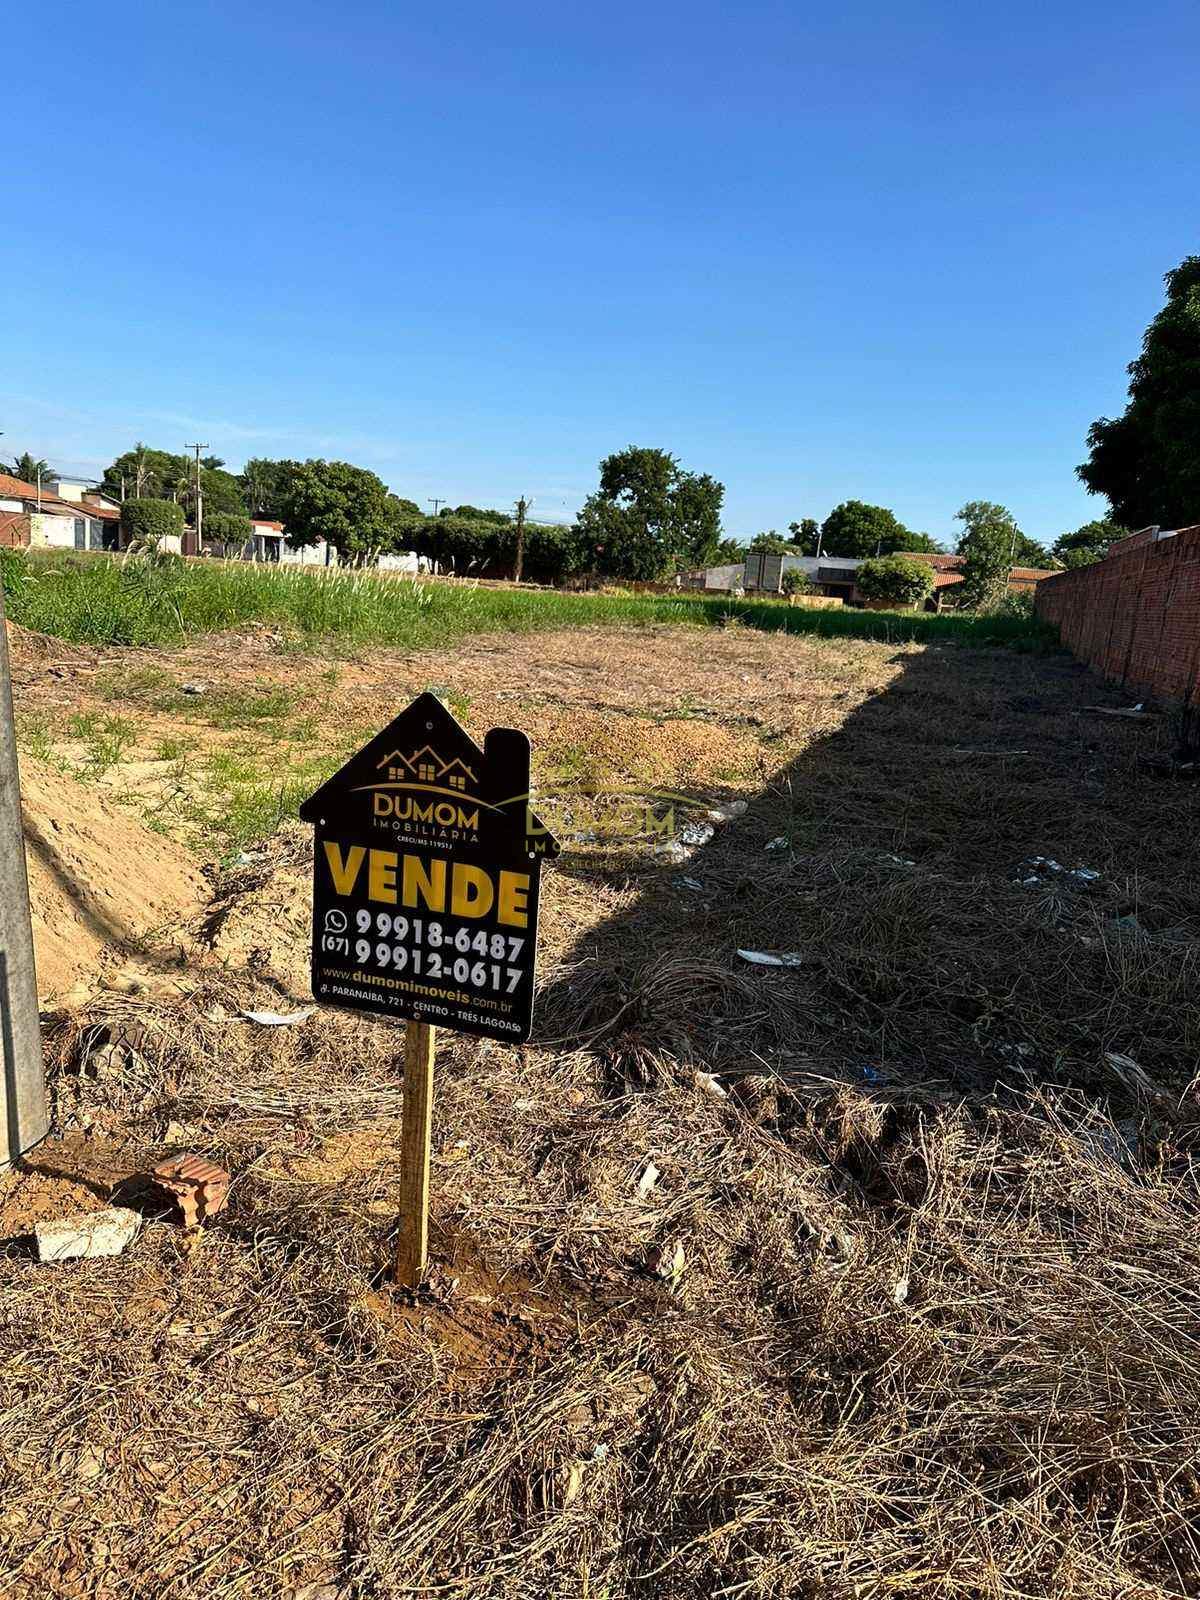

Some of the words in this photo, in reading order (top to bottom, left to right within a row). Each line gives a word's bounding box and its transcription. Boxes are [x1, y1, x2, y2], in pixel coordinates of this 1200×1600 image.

[374, 792, 479, 831] DUMOM
[373, 817, 479, 842] IMOBILIÁRIA
[322, 840, 530, 928] VENDE
[321, 934, 349, 956] (67)
[321, 967, 513, 1013] www.dumomimoveis.com.br
[388, 996, 404, 1006] 721
[413, 1001, 449, 1016] CENTRO
[457, 1010, 478, 1023] TRÊS
